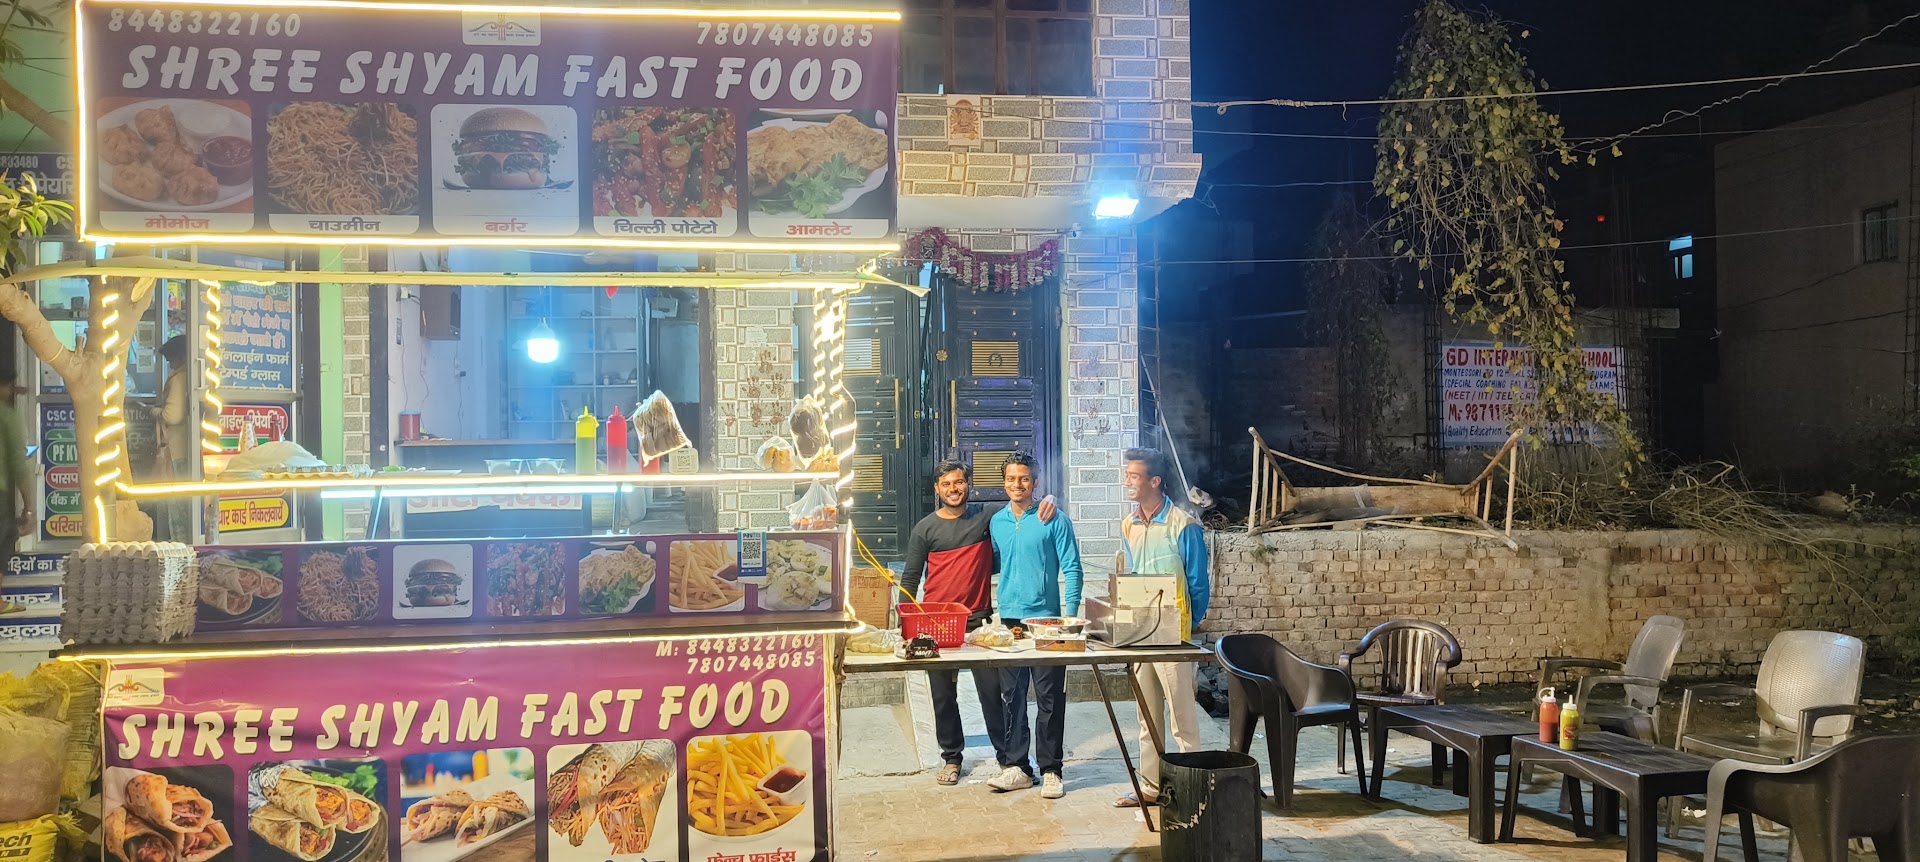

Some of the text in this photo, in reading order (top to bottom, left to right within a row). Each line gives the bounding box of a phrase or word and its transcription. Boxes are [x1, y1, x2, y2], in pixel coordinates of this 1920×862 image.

[108, 8, 301, 37] 8448322160
[697, 22, 874, 47] 7807448085
[122, 45, 863, 101] SHREE SHYAM FAST FOOD
[144, 214, 210, 229] मोमोज
[308, 217, 381, 232] चाउमीन
[484, 217, 528, 234] बर्गर
[613, 218, 718, 234] चिल्ली पोटेटो
[786, 222, 852, 236] आमलेट
[1446, 348, 1468, 366] GD
[1581, 352, 1617, 368] CHOOL
[1443, 368, 1482, 378] MONTESSORI
[1591, 370, 1617, 379] UGRAM
[1475, 380, 1506, 389] COACHING
[1590, 382, 1615, 390] EXAMS
[46, 410, 67, 421] CSC
[52, 444, 64, 461] PF
[51, 472, 79, 484] पासप
[37, 559, 54, 571] का
[655, 633, 815, 657] M: 8448322160
[687, 650, 816, 675] 7807448085
[118, 707, 298, 760] SHREE
[316, 695, 498, 750] SHYAM
[520, 688, 643, 739] FAST
[659, 679, 790, 731] FOOD
